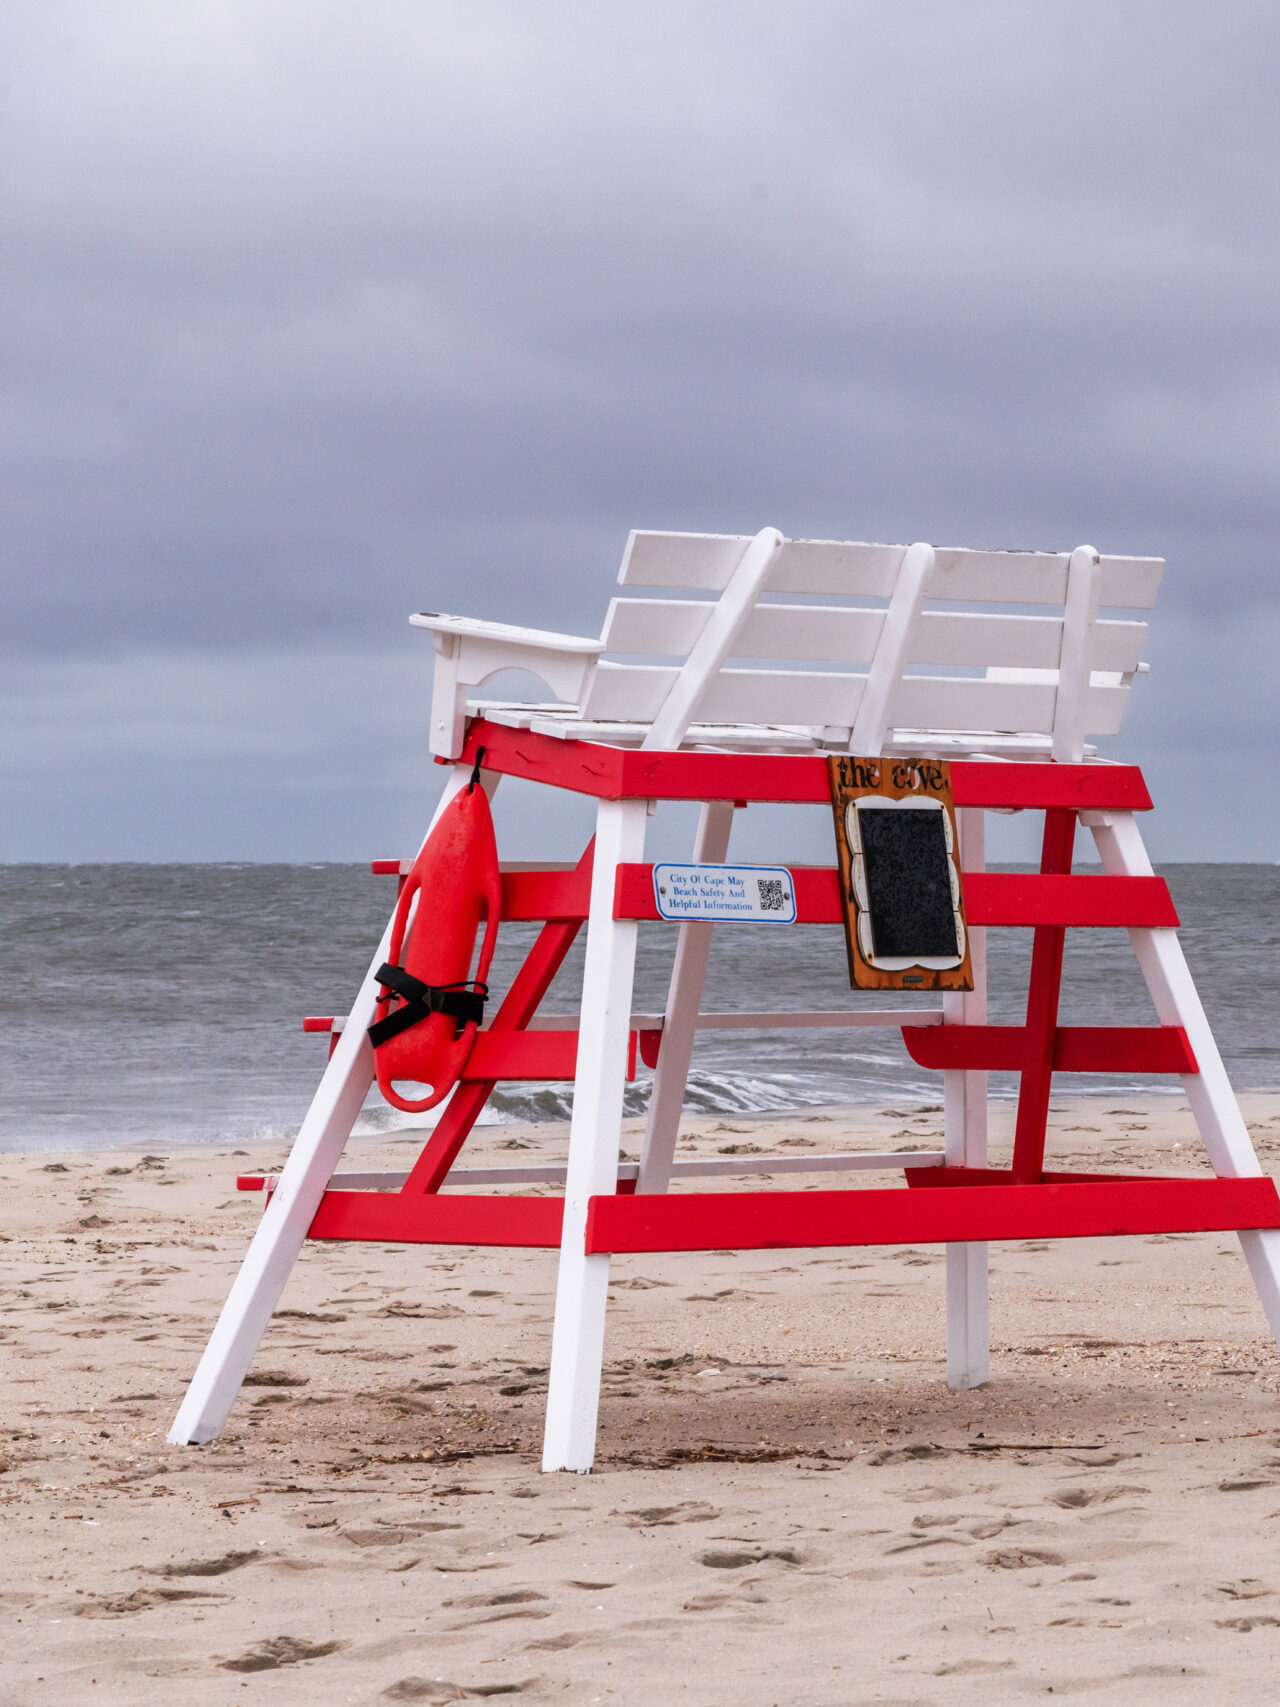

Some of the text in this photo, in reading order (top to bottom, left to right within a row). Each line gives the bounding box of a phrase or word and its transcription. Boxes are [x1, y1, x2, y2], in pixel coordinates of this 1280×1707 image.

[837, 756, 881, 789] the
[670, 873, 745, 889] City Of Cape May
[673, 887, 746, 900] Beach Safety And
[669, 899, 753, 911] Helpful Information
